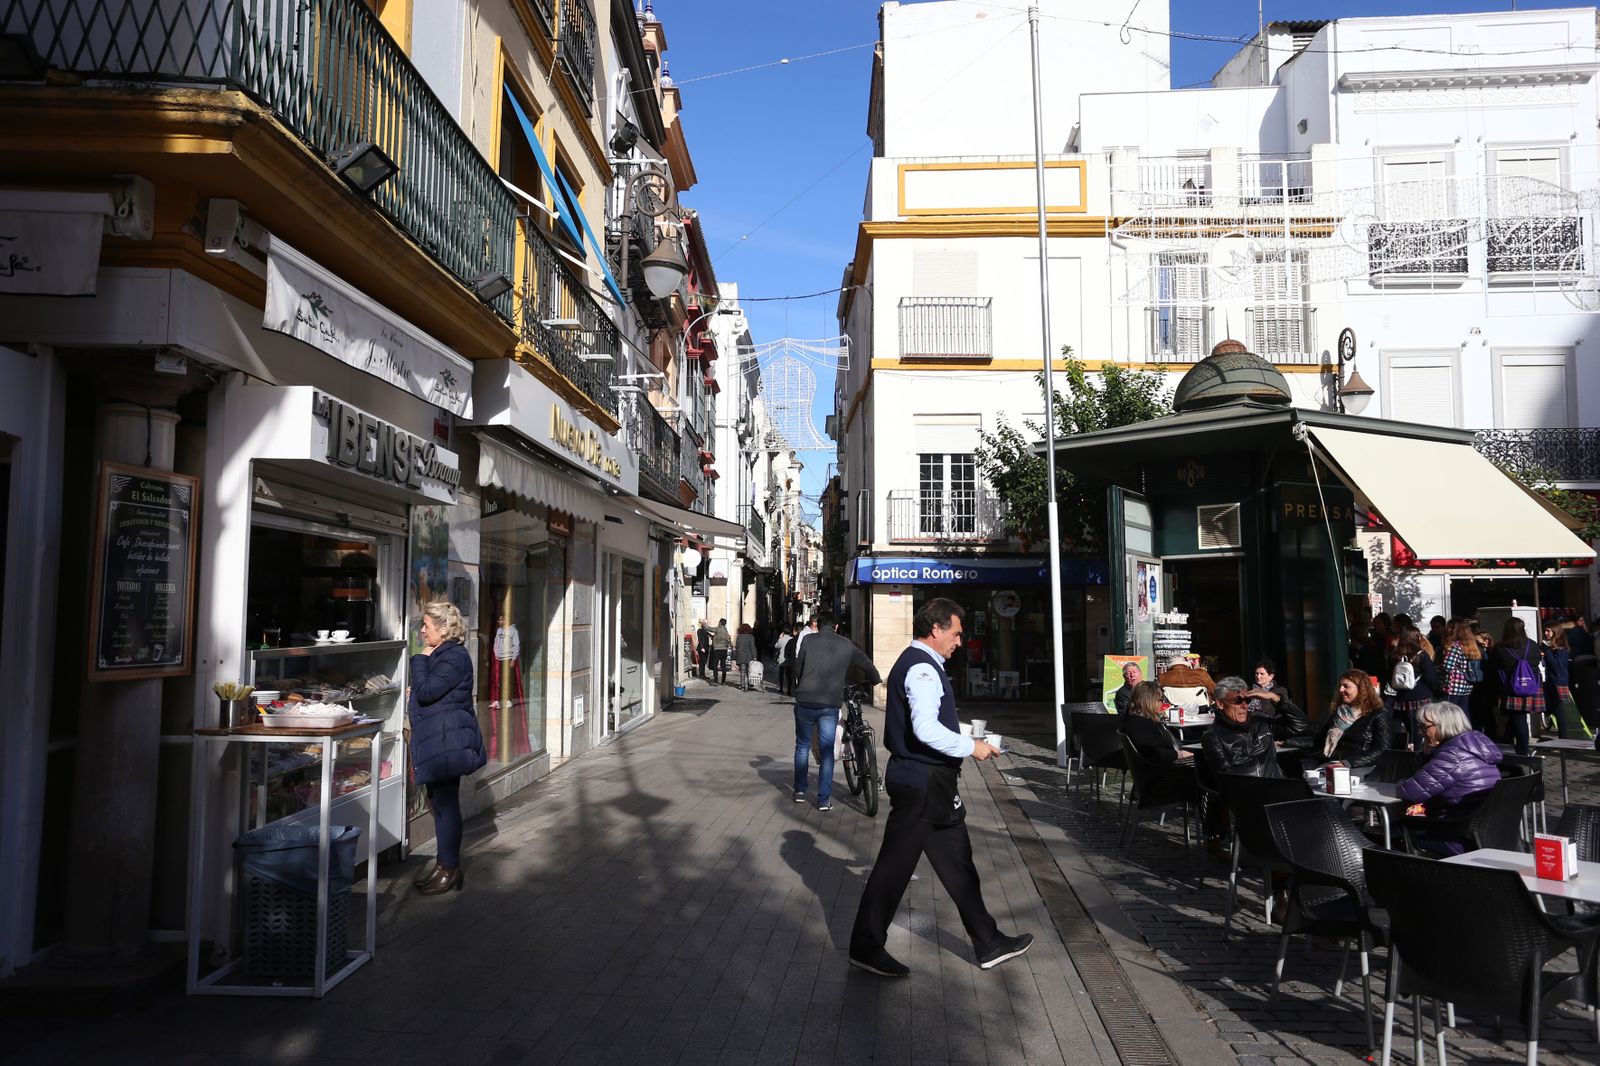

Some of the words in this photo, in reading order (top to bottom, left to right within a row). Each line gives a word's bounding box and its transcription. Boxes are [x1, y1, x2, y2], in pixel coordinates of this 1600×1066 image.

[549, 403, 585, 457] Nuevo
[312, 391, 330, 419] LA
[326, 399, 424, 490] IBENSE
[131, 490, 140, 500] El
[1283, 503, 1354, 520] PRENSA
[872, 566, 918, 581] óptica
[922, 567, 979, 580] Romero
